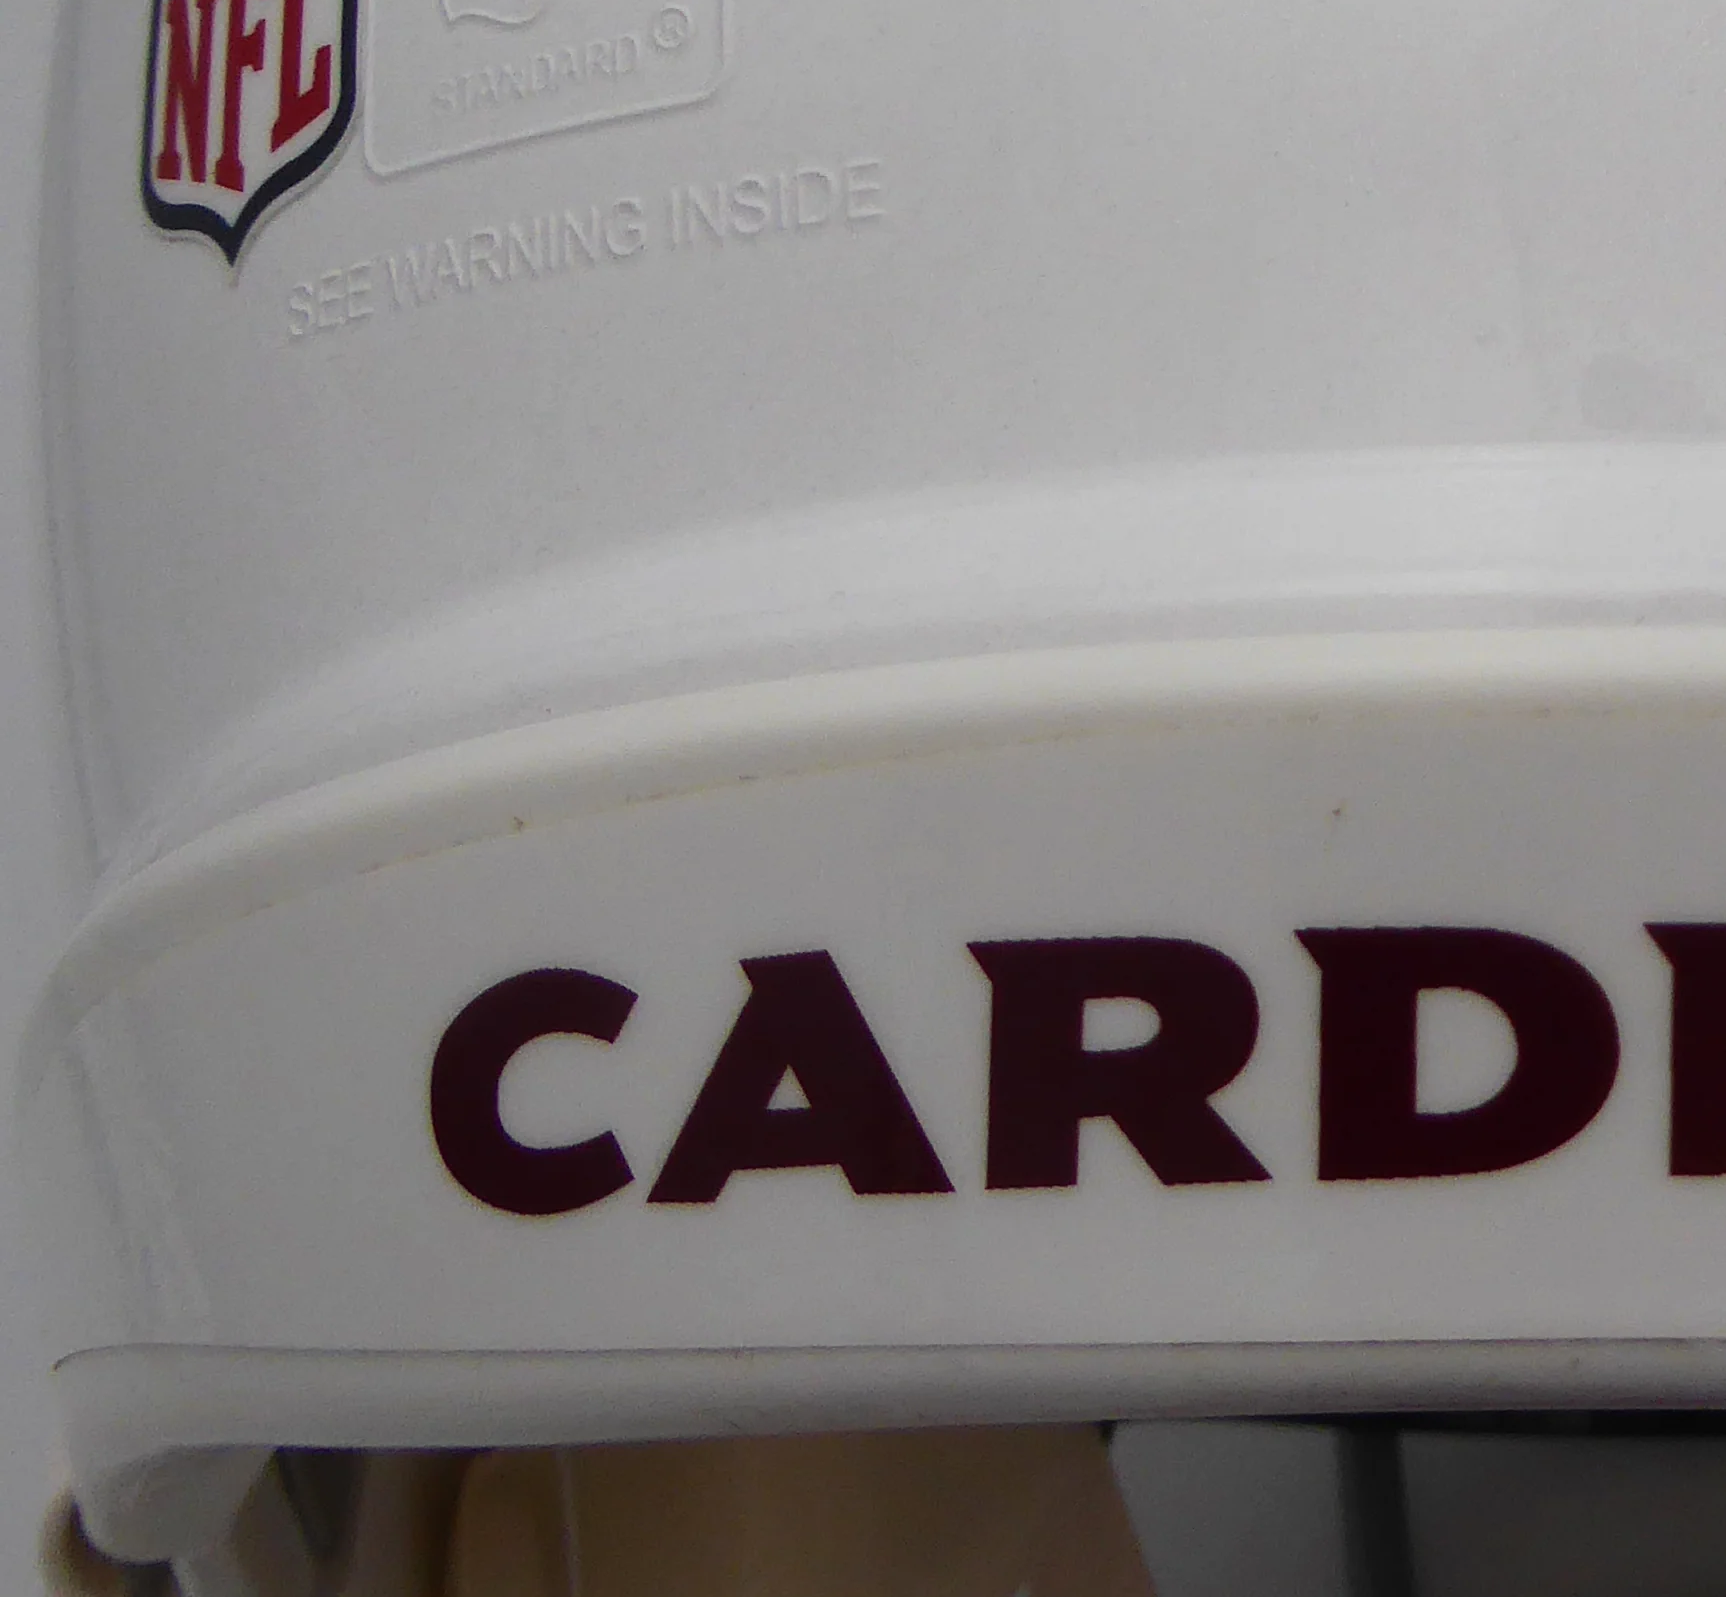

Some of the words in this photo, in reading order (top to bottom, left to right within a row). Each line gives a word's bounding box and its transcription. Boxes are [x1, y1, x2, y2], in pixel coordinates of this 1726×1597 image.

[430, 30, 639, 119] STANDARD
[288, 262, 374, 343] SEE
[383, 196, 648, 310] WARNING
[668, 157, 886, 247] INSIDE
